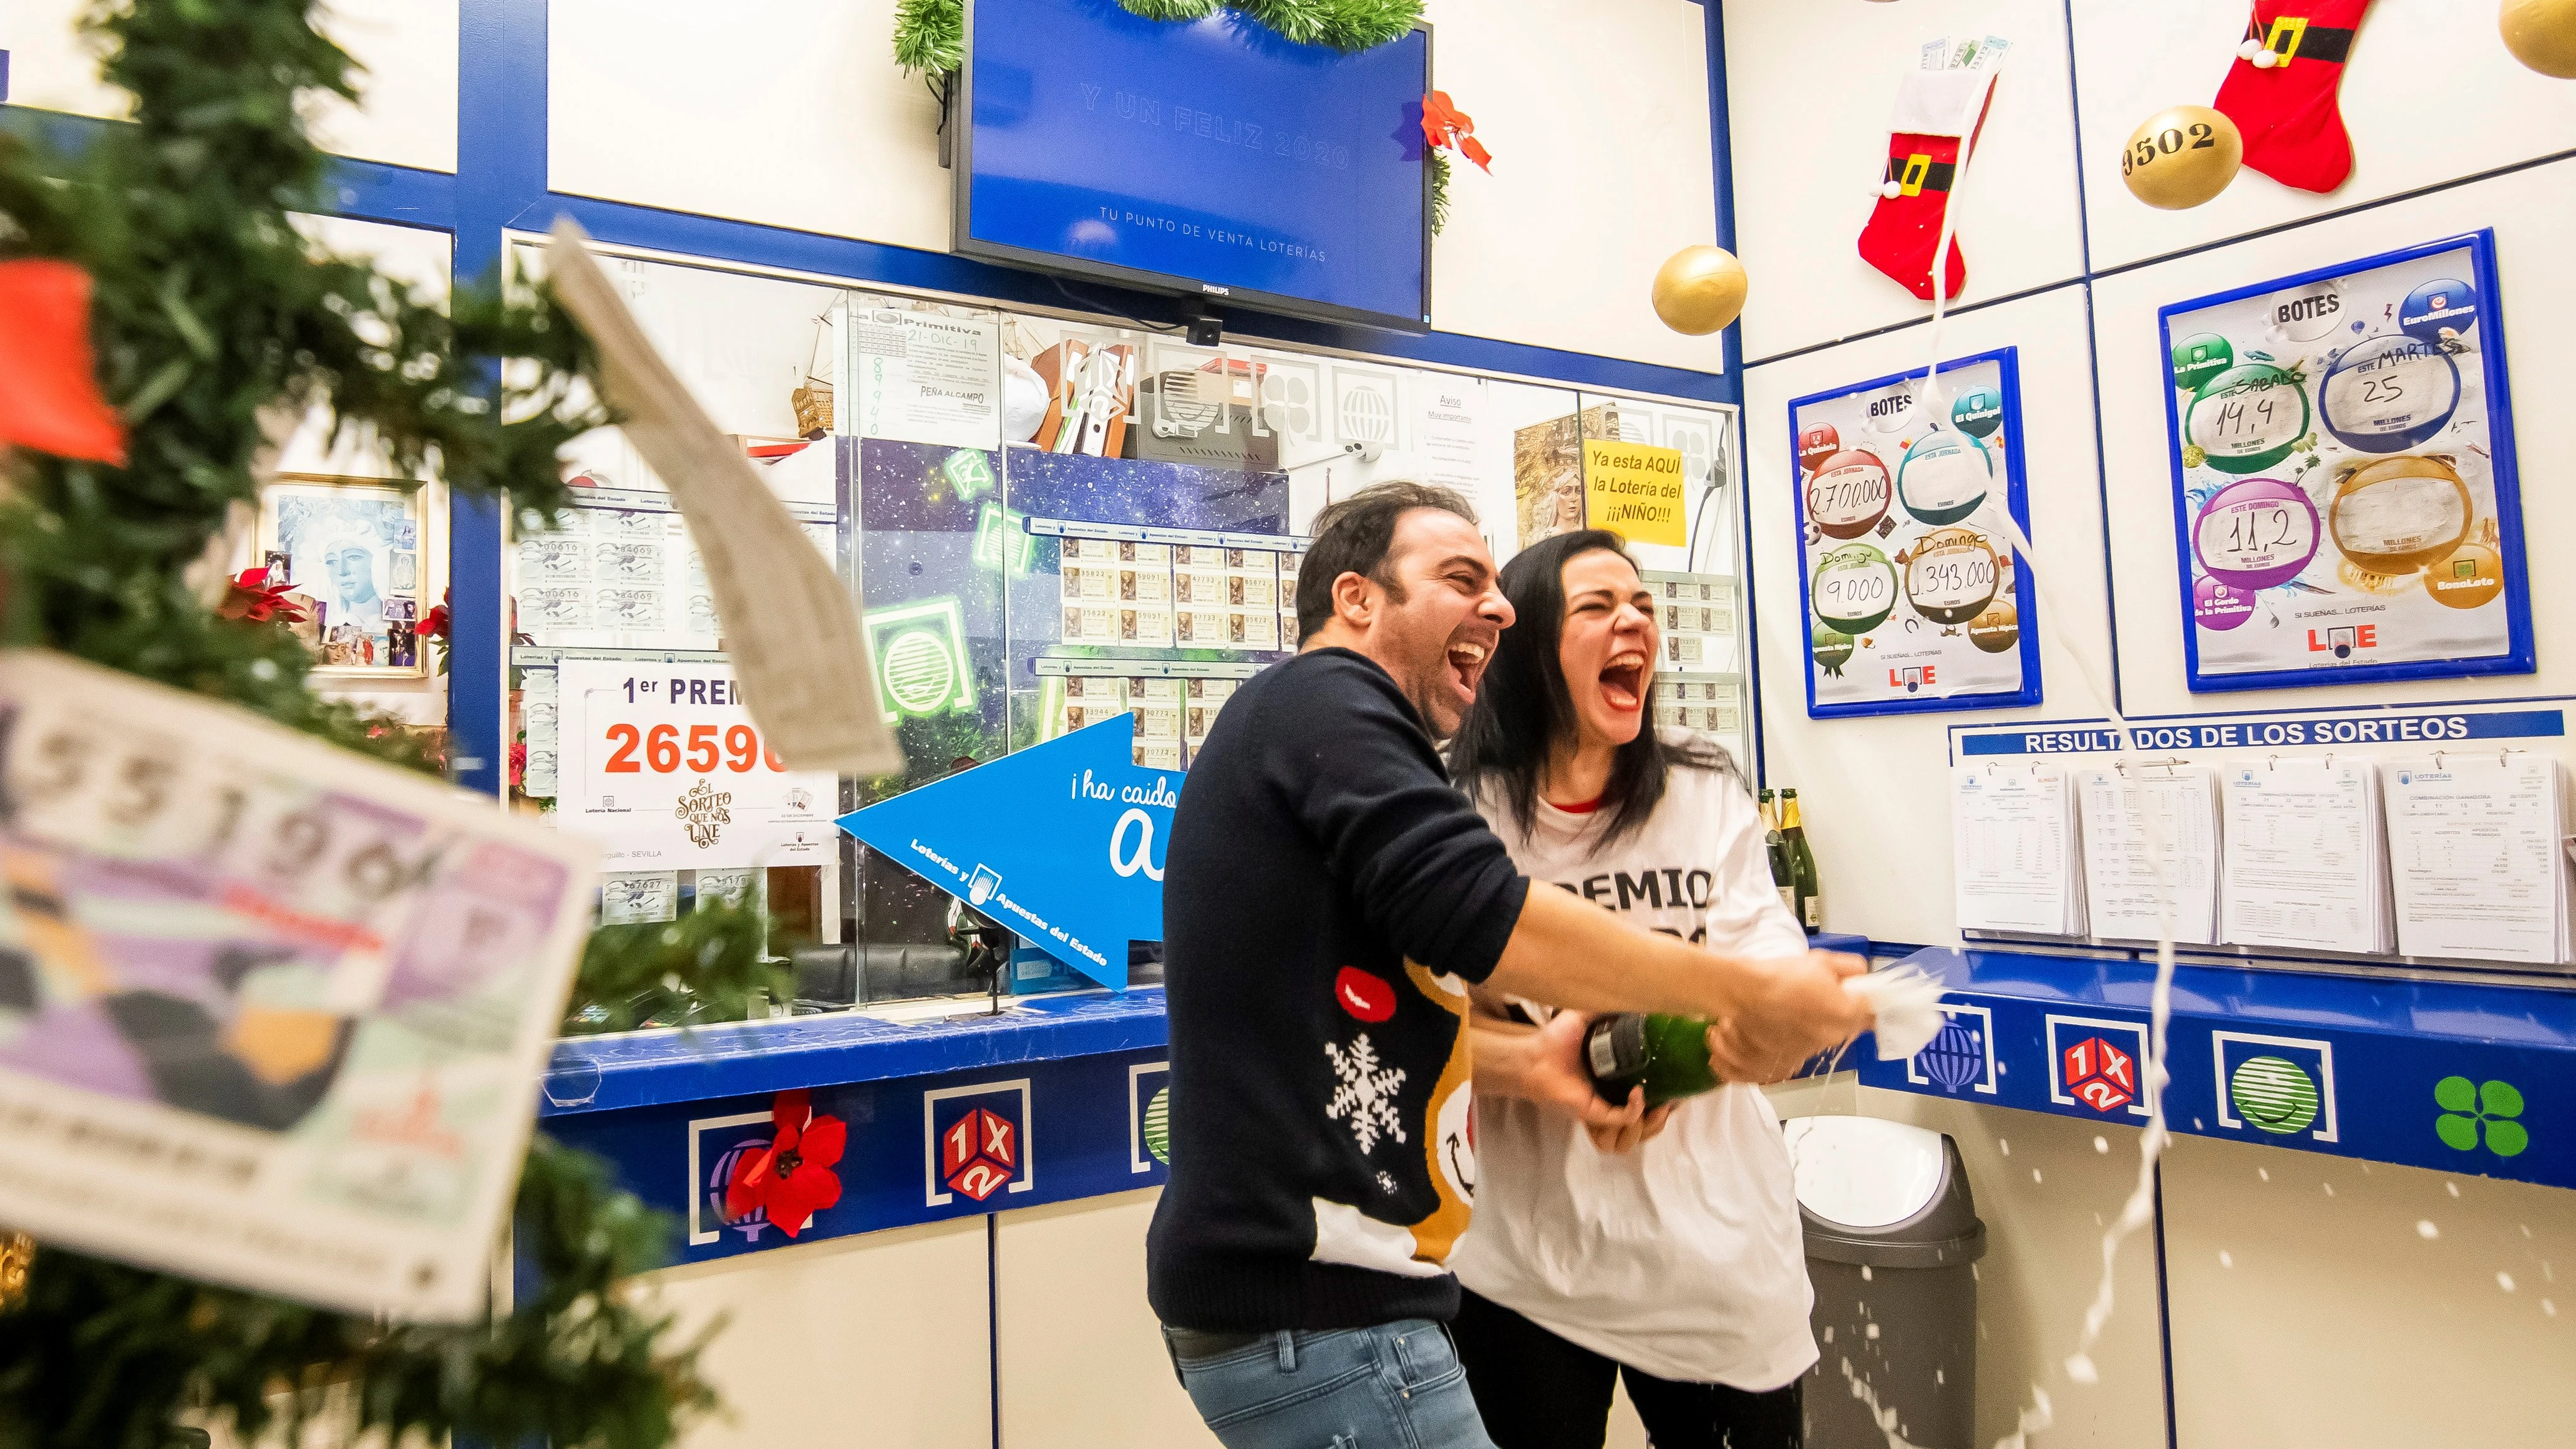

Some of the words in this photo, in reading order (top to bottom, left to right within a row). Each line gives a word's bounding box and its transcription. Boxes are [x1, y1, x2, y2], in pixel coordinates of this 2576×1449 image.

[1080, 83, 1101, 110] Y
[1115, 91, 1160, 126] UN
[1175, 106, 1263, 150] FELIZ
[1275, 132, 1349, 170] 2020
[2122, 123, 2215, 177] 9502
[1100, 206, 1118, 221] TU
[1126, 212, 1175, 232] PUNTO
[1183, 223, 1200, 238] DE
[1208, 228, 1253, 248] VENTA
[1202, 284, 1229, 296] PHILIPS
[2278, 294, 2340, 323] BOTES
[2403, 304, 2475, 326] EuroMillones
[904, 318, 981, 336] Primitiva
[2187, 357, 2227, 372] Primitiva
[2358, 363, 2375, 374] ESTE
[920, 385, 942, 397] PEÑA
[945, 389, 984, 404] ALCAMPO
[2220, 390, 2236, 400] ESTE
[2363, 375, 2403, 403] 25
[1440, 395, 1461, 407] Aviso
[1870, 394, 1913, 417] BOTES
[1428, 410, 1441, 419] Muy
[1442, 414, 1472, 423] importante
[1955, 414, 1964, 423] El
[1965, 406, 2001, 421] Quinigol
[2217, 399, 2274, 437] 14,4
[2373, 414, 2411, 426] MILLONES
[1807, 442, 1837, 456] Quiniela
[1938, 448, 1961, 457] JORNADA
[2231, 438, 2265, 449] MILLONES
[1593, 450, 1609, 467] Ya
[1613, 455, 1642, 470] esta
[1645, 456, 1681, 474] AQUÍ
[1594, 475, 1606, 492] la
[1610, 477, 1657, 497] Lotería
[1661, 483, 1681, 500] del
[1606, 502, 1671, 523] ¡¡¡NIÑO!!!
[2231, 506, 2247, 514] ESTE
[2248, 501, 2279, 510] DOMINGO
[2227, 509, 2297, 553] 11,2
[2383, 535, 2421, 546] MILLONES
[1913, 534, 1988, 555] Domingo
[2240, 554, 2275, 564] MILLONES
[1826, 576, 1883, 604] 9.000
[2437, 577, 2494, 591] BonoLoto
[2214, 597, 2239, 606] Gordo
[2215, 604, 2252, 614] Primitiva
[2295, 611, 2302, 619] SI
[622, 677, 658, 704] 1er
[2024, 727, 2192, 752] RESULTADOS
[2201, 726, 2238, 747] DE
[2247, 722, 2305, 745] LOS
[2314, 716, 2469, 743] SORTEOS
[1121, 775, 1177, 809] caido
[675, 792, 732, 820] SORTEO
[689, 812, 709, 825] QUE
[711, 807, 731, 825] NOS
[1553, 868, 1713, 912] EMIO
[910, 838, 960, 876] Loterías
[959, 870, 970, 884] y
[996, 893, 1048, 931] Apuestas
[1049, 923, 1070, 944] del
[1069, 939, 1108, 967] Estado
